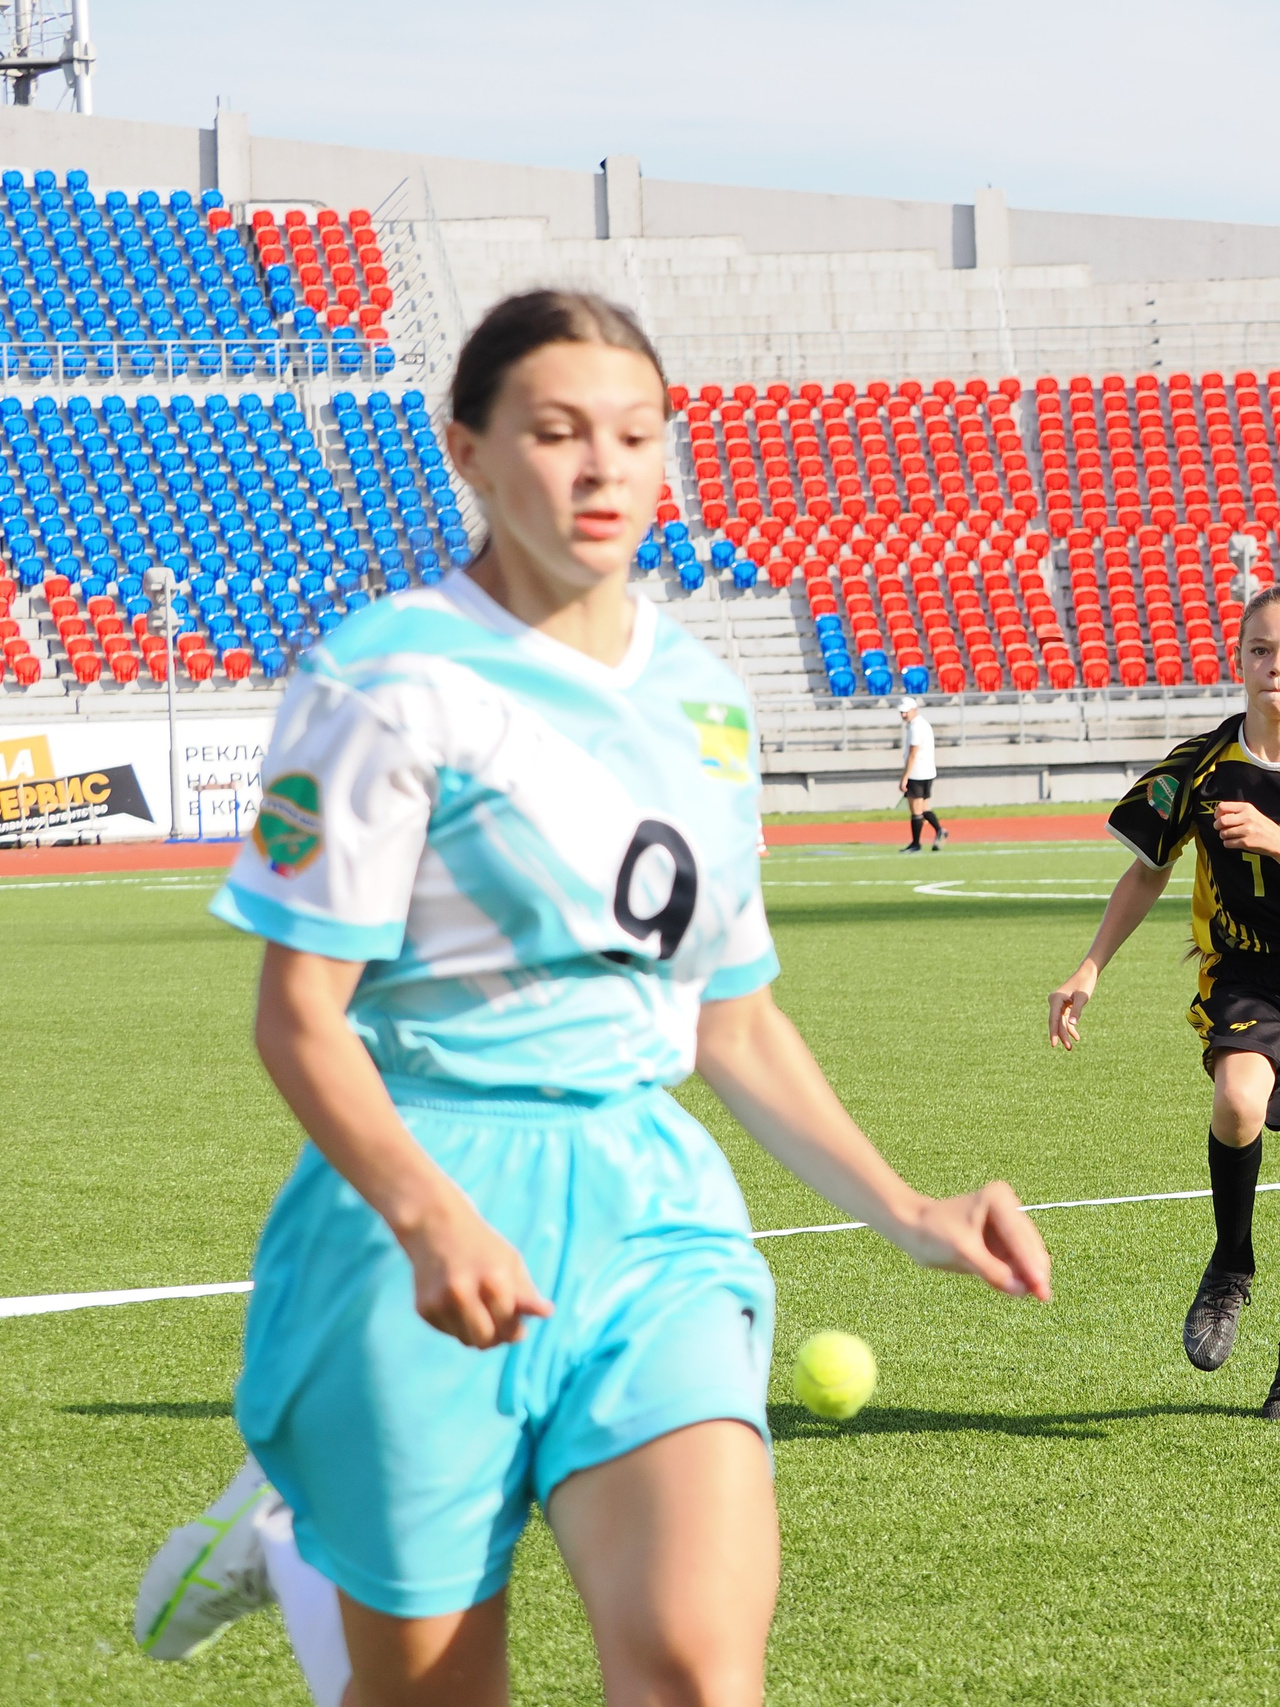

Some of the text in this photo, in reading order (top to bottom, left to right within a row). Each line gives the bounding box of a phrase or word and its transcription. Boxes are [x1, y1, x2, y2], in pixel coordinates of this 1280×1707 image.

[185, 745, 266, 762] РЕКЛА
[0, 772, 112, 821] ЕРВИС
[610, 819, 698, 962] 9
